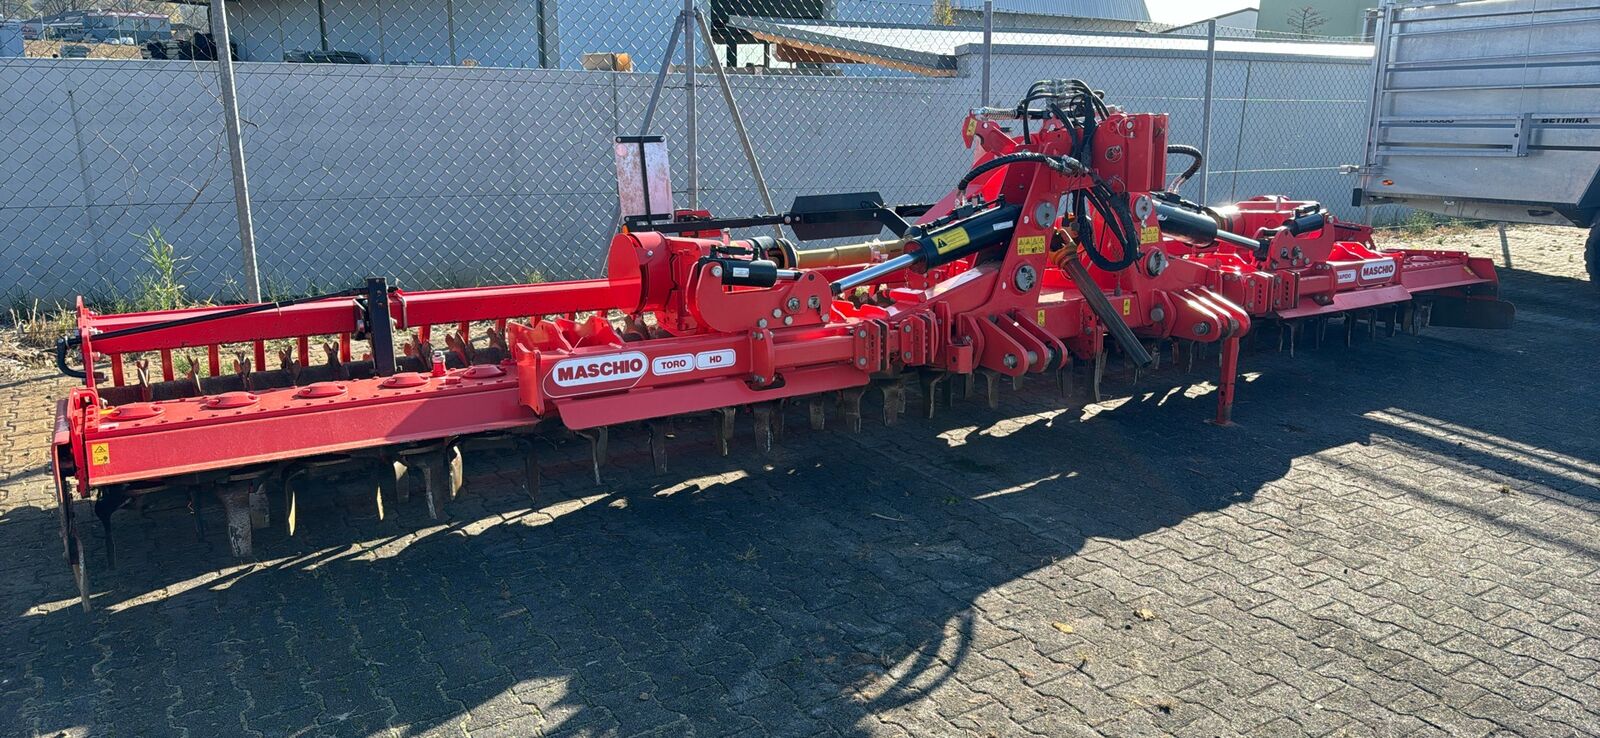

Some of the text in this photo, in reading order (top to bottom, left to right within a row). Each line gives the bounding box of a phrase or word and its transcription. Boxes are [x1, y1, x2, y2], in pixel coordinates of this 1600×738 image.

[1363, 265, 1393, 276] MASCHIO
[558, 355, 722, 381] MASCHIO TORO HD
